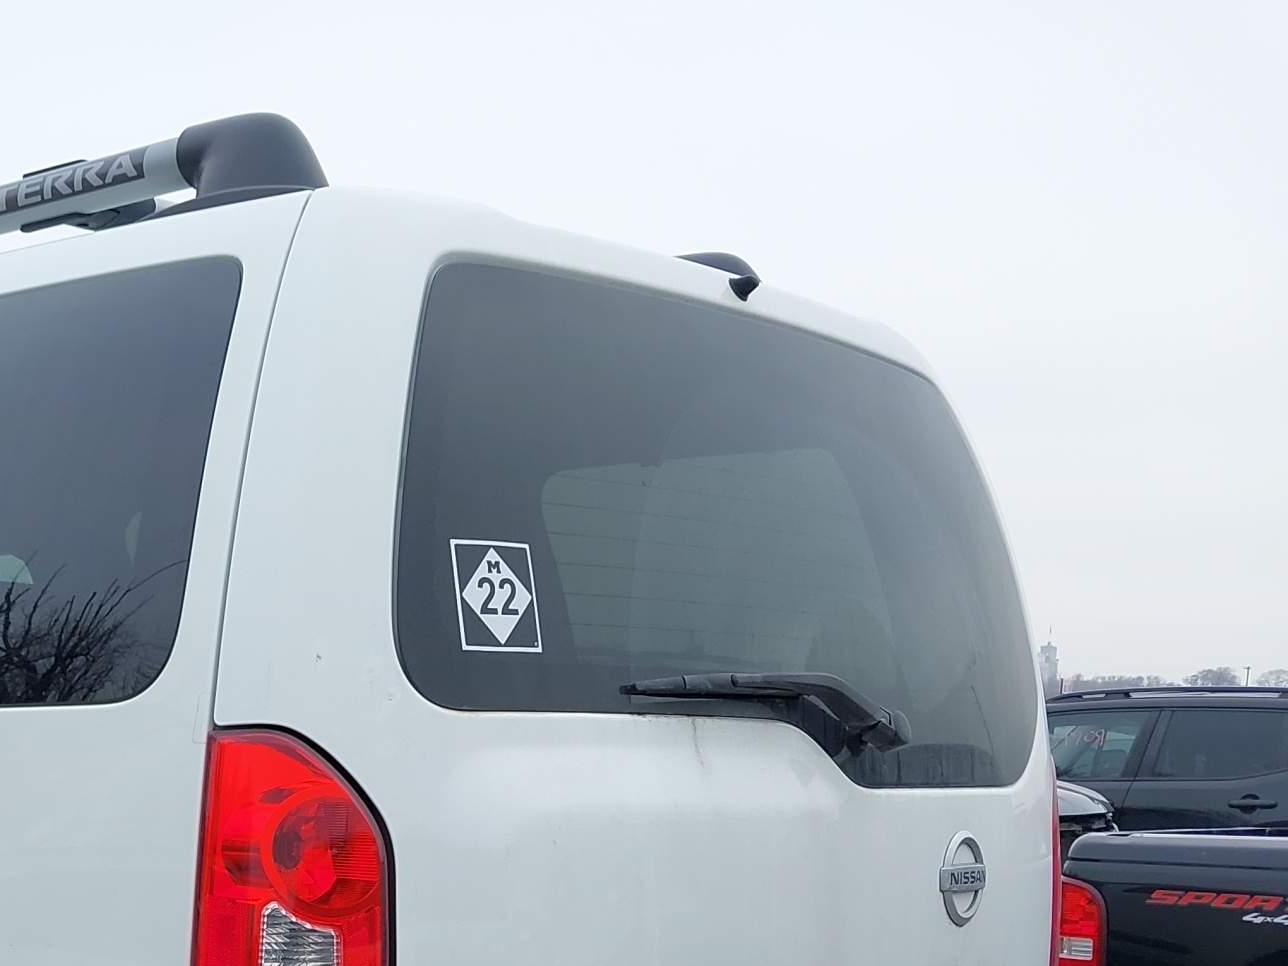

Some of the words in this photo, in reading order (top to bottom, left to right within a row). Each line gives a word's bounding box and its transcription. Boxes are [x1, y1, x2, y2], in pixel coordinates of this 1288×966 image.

[486, 560, 502, 574] M
[477, 576, 520, 616] 22
[1146, 889, 1288, 912] SPOR
